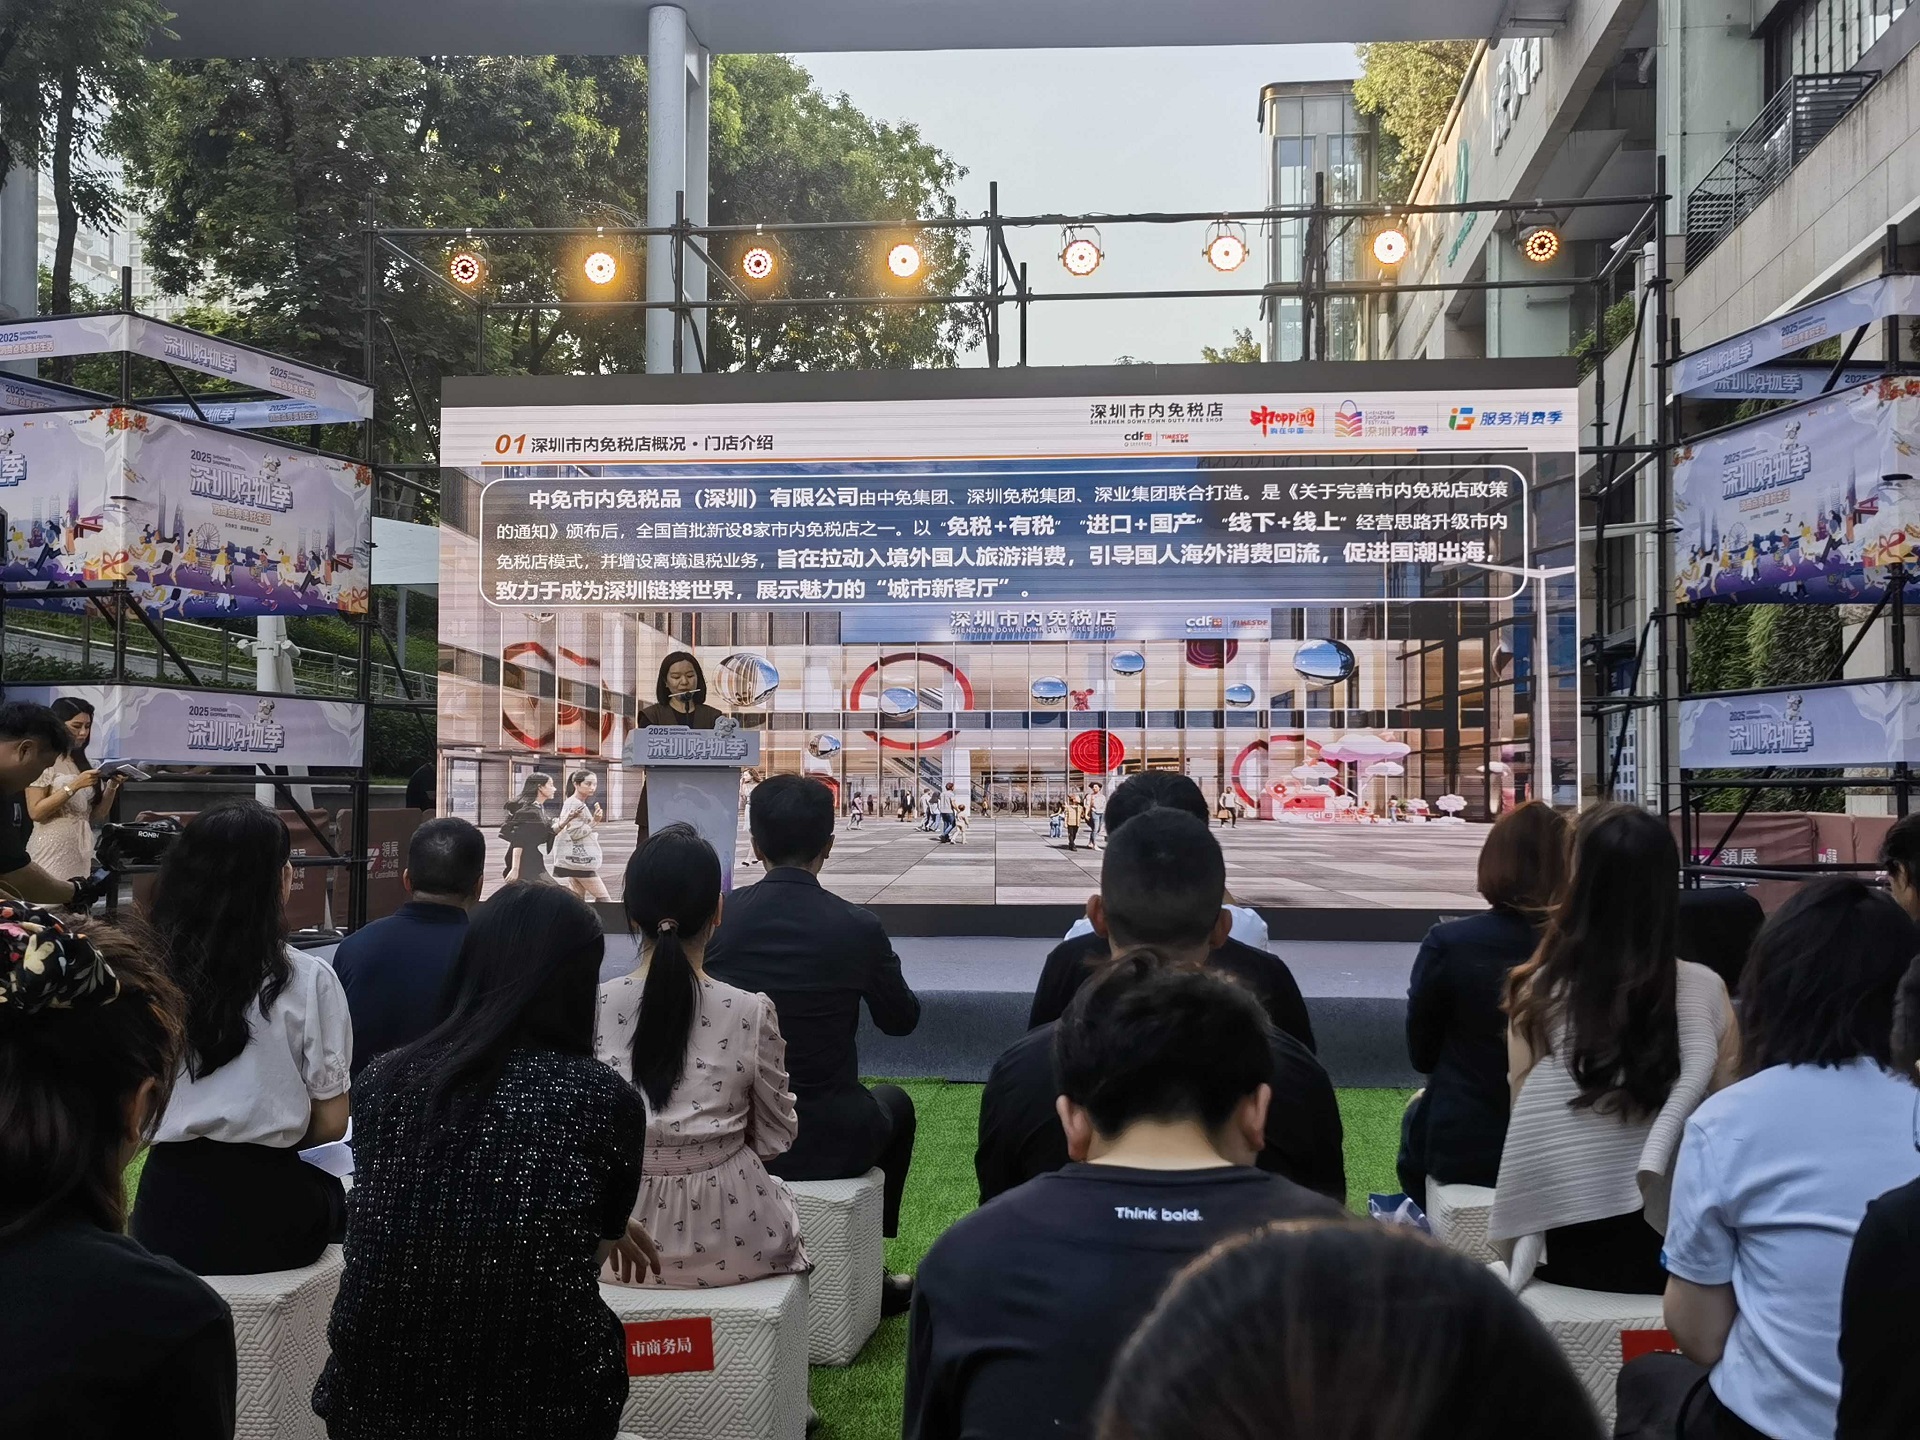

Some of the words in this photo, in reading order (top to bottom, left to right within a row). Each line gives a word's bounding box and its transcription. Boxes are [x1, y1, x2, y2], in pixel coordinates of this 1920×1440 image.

[163, 335, 238, 375] 深圳购物季
[270, 366, 288, 379] 2025
[6, 384, 25, 396] 2025
[1090, 402, 1223, 419] 深圳市内免税店
[1480, 410, 1564, 426] 服务消费季
[1124, 431, 1144, 441] cdf
[1365, 425, 1429, 437] 深圳购物季
[495, 434, 527, 454] 01
[191, 450, 212, 463] 2025
[1722, 445, 1811, 500] 深圳购物季
[190, 464, 293, 513] 深圳购物季
[950, 608, 1118, 627] 深圳市内免税店
[1186, 615, 1213, 627] cdf
[189, 705, 209, 717] 2025
[187, 719, 285, 753] 深圳购物季
[648, 727, 669, 735] 2025
[1729, 720, 1814, 755] 深圳购物季
[647, 738, 748, 760] 深圳购物季
[1720, 848, 1758, 865] 領展
[1114, 1206, 1157, 1220] Think
[1161, 1208, 1204, 1221] bold.
[630, 1337, 692, 1357] 市商务局
